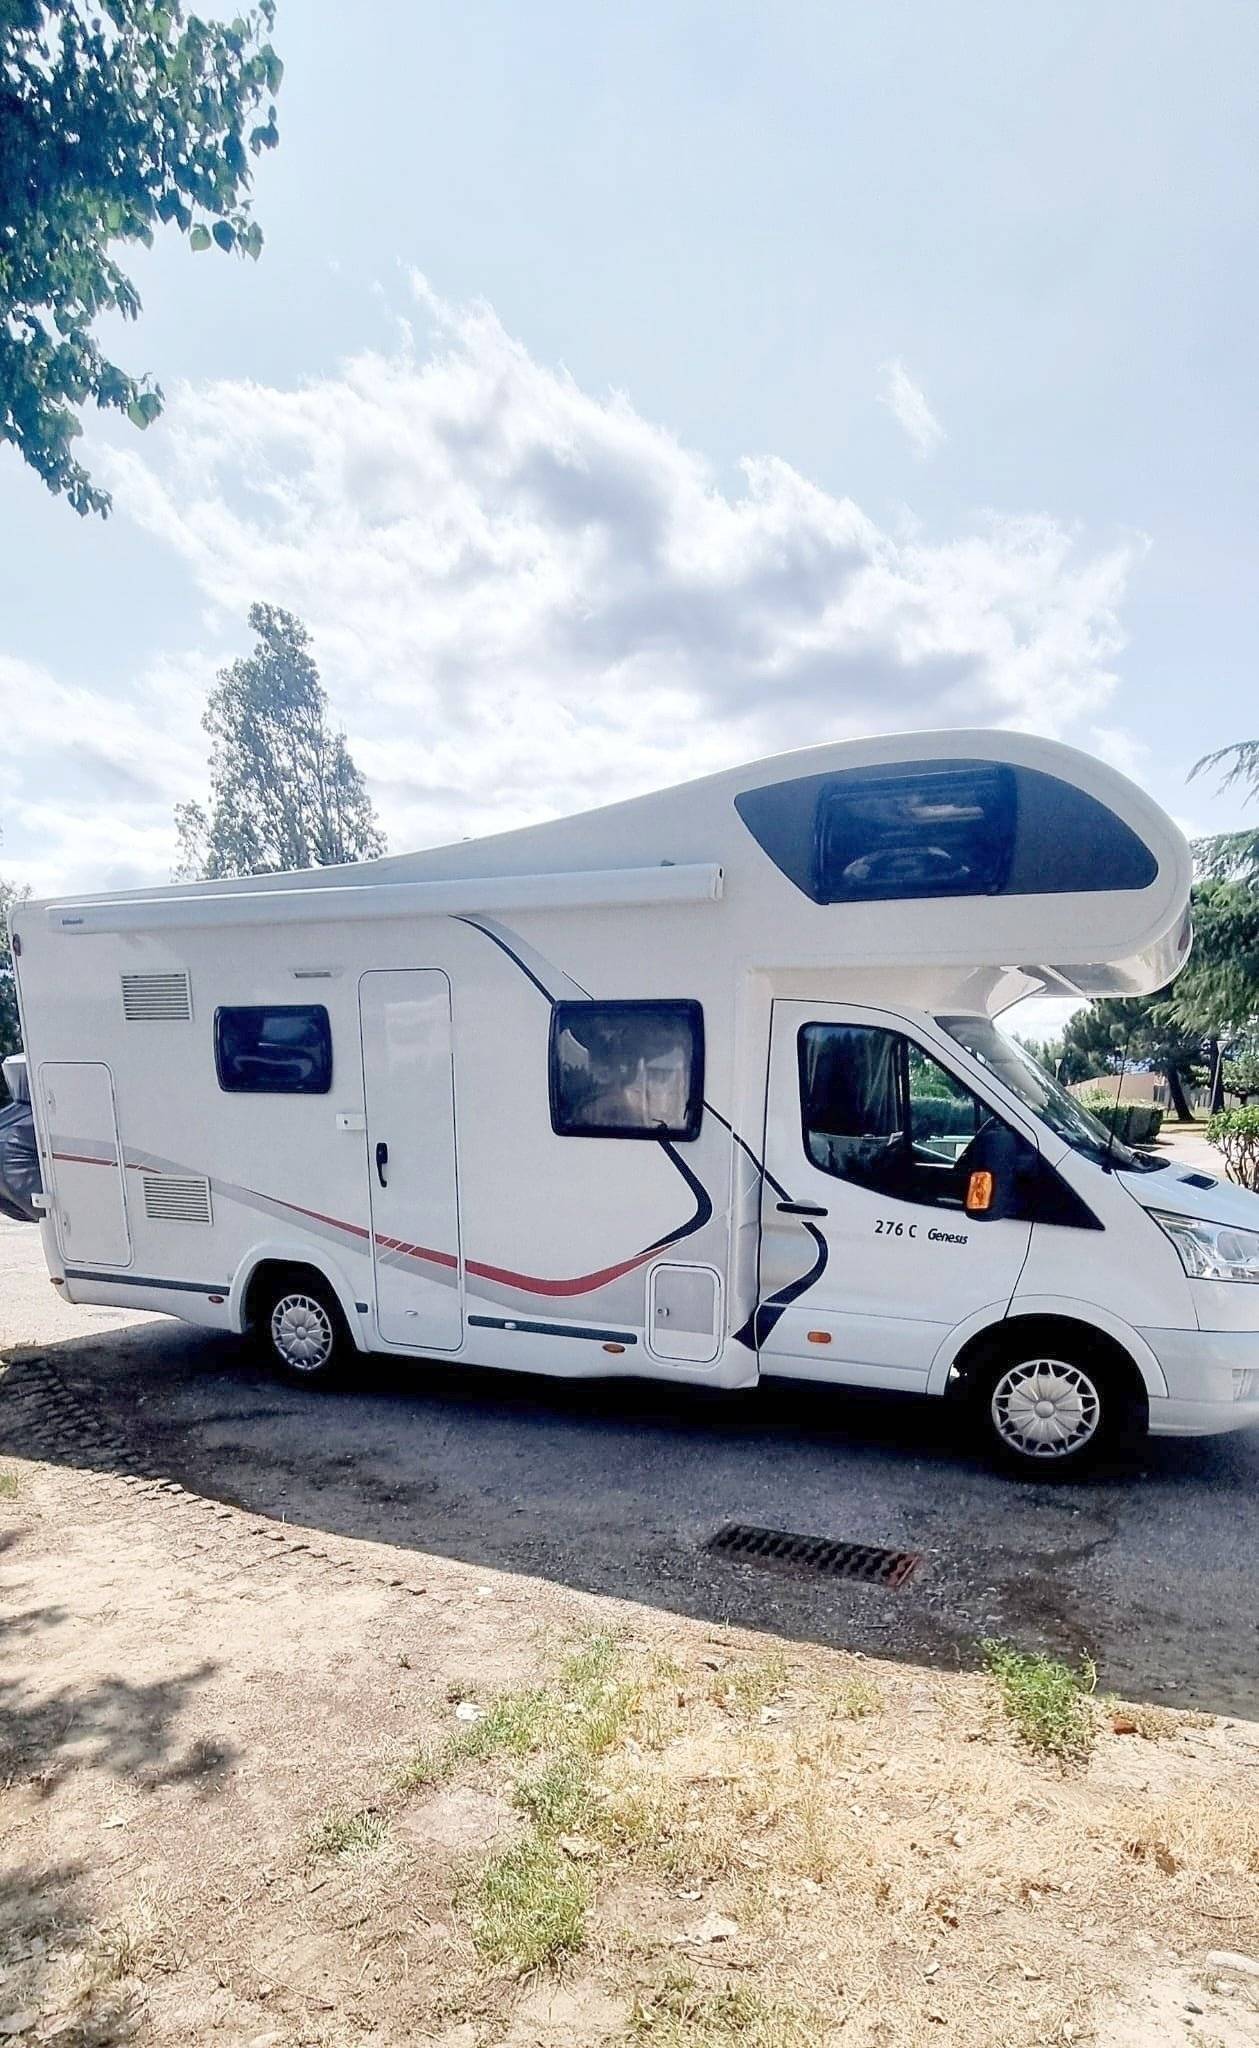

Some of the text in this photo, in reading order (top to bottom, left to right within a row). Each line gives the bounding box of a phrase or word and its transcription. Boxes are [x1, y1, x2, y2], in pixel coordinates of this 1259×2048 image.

[875, 1220, 968, 1245] 276 C Genesis
